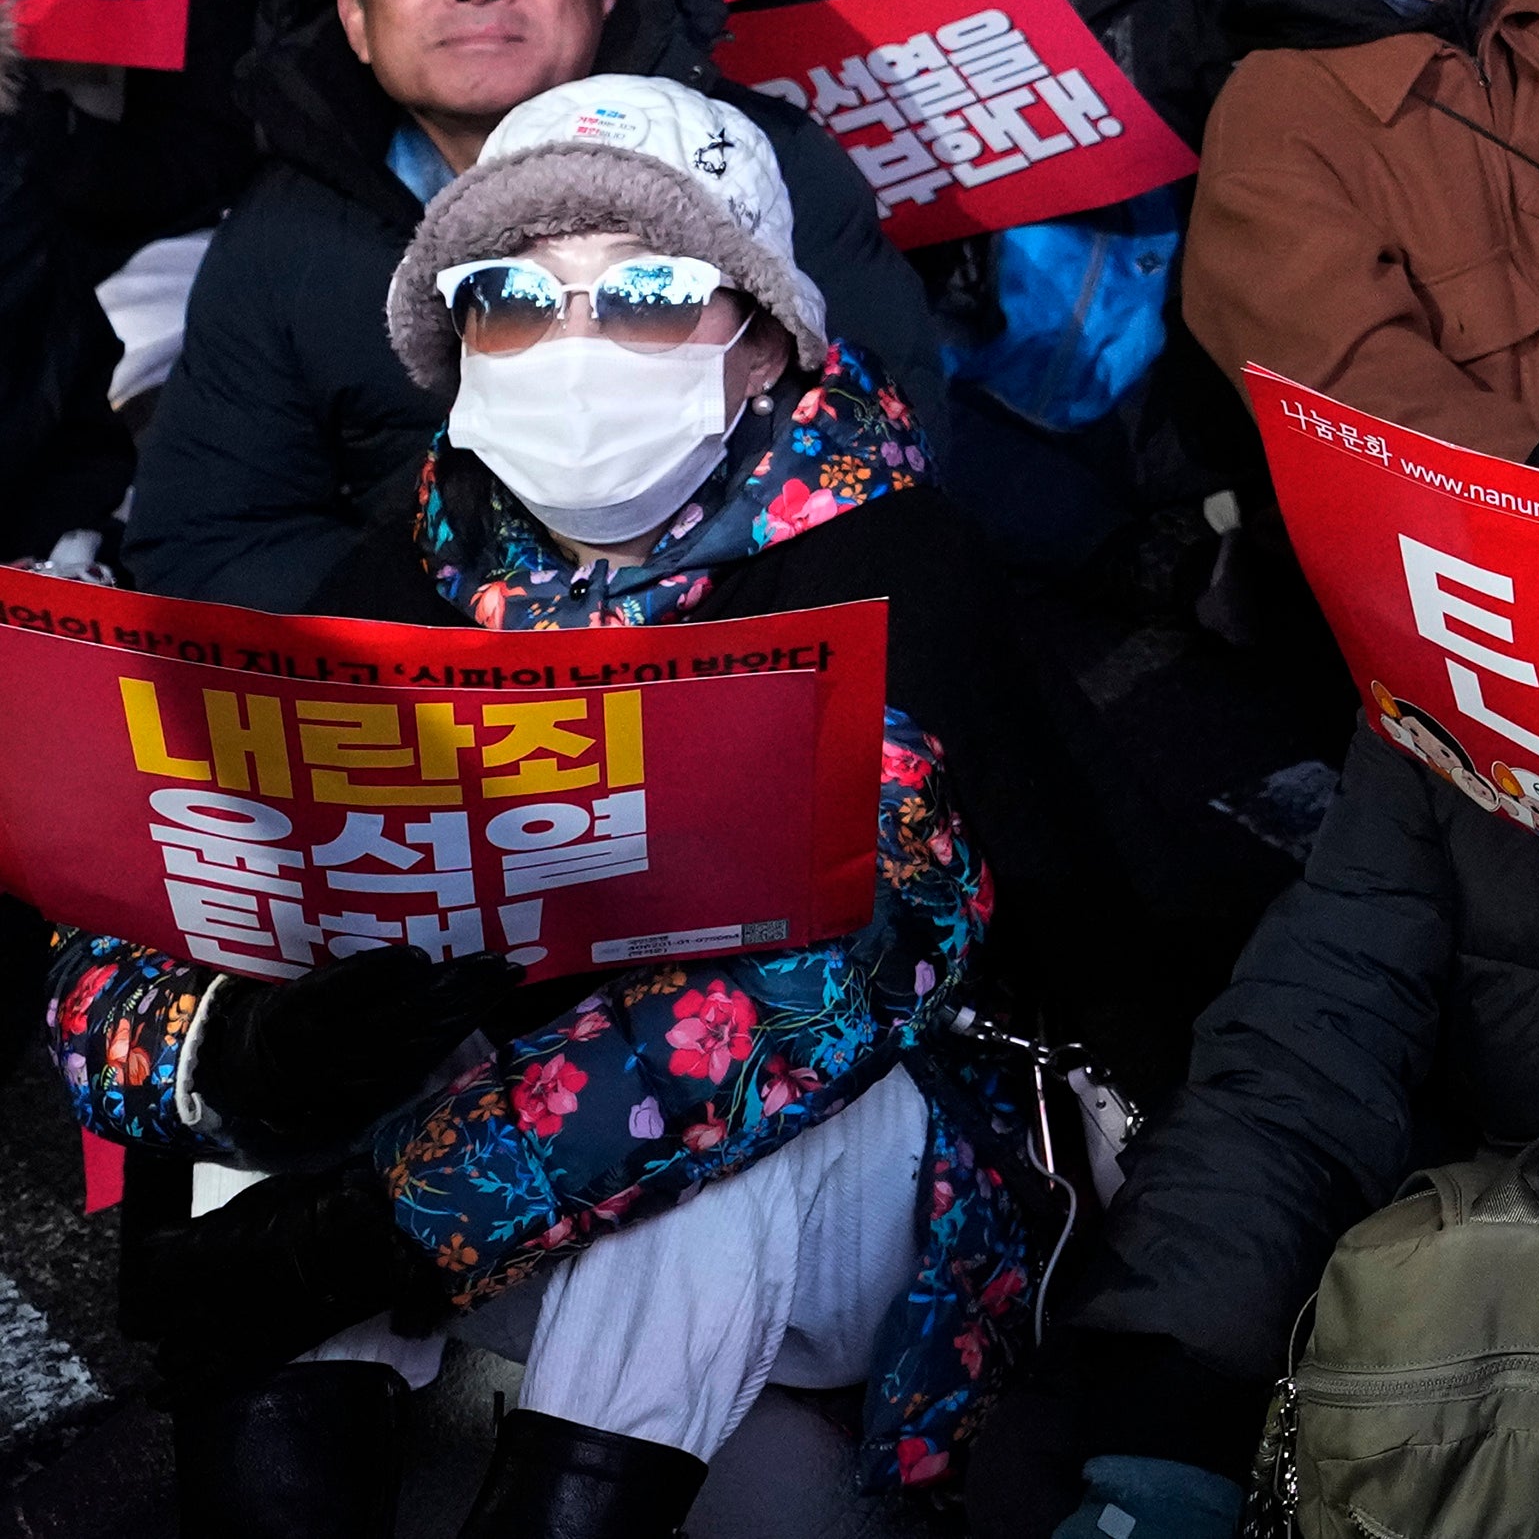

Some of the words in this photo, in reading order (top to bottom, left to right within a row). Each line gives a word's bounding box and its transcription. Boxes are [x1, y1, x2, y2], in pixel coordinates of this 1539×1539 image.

[1280, 399, 1393, 466] 나눔문화
[119, 677, 644, 806] 내란죄
[148, 787, 650, 909] 윤석열
